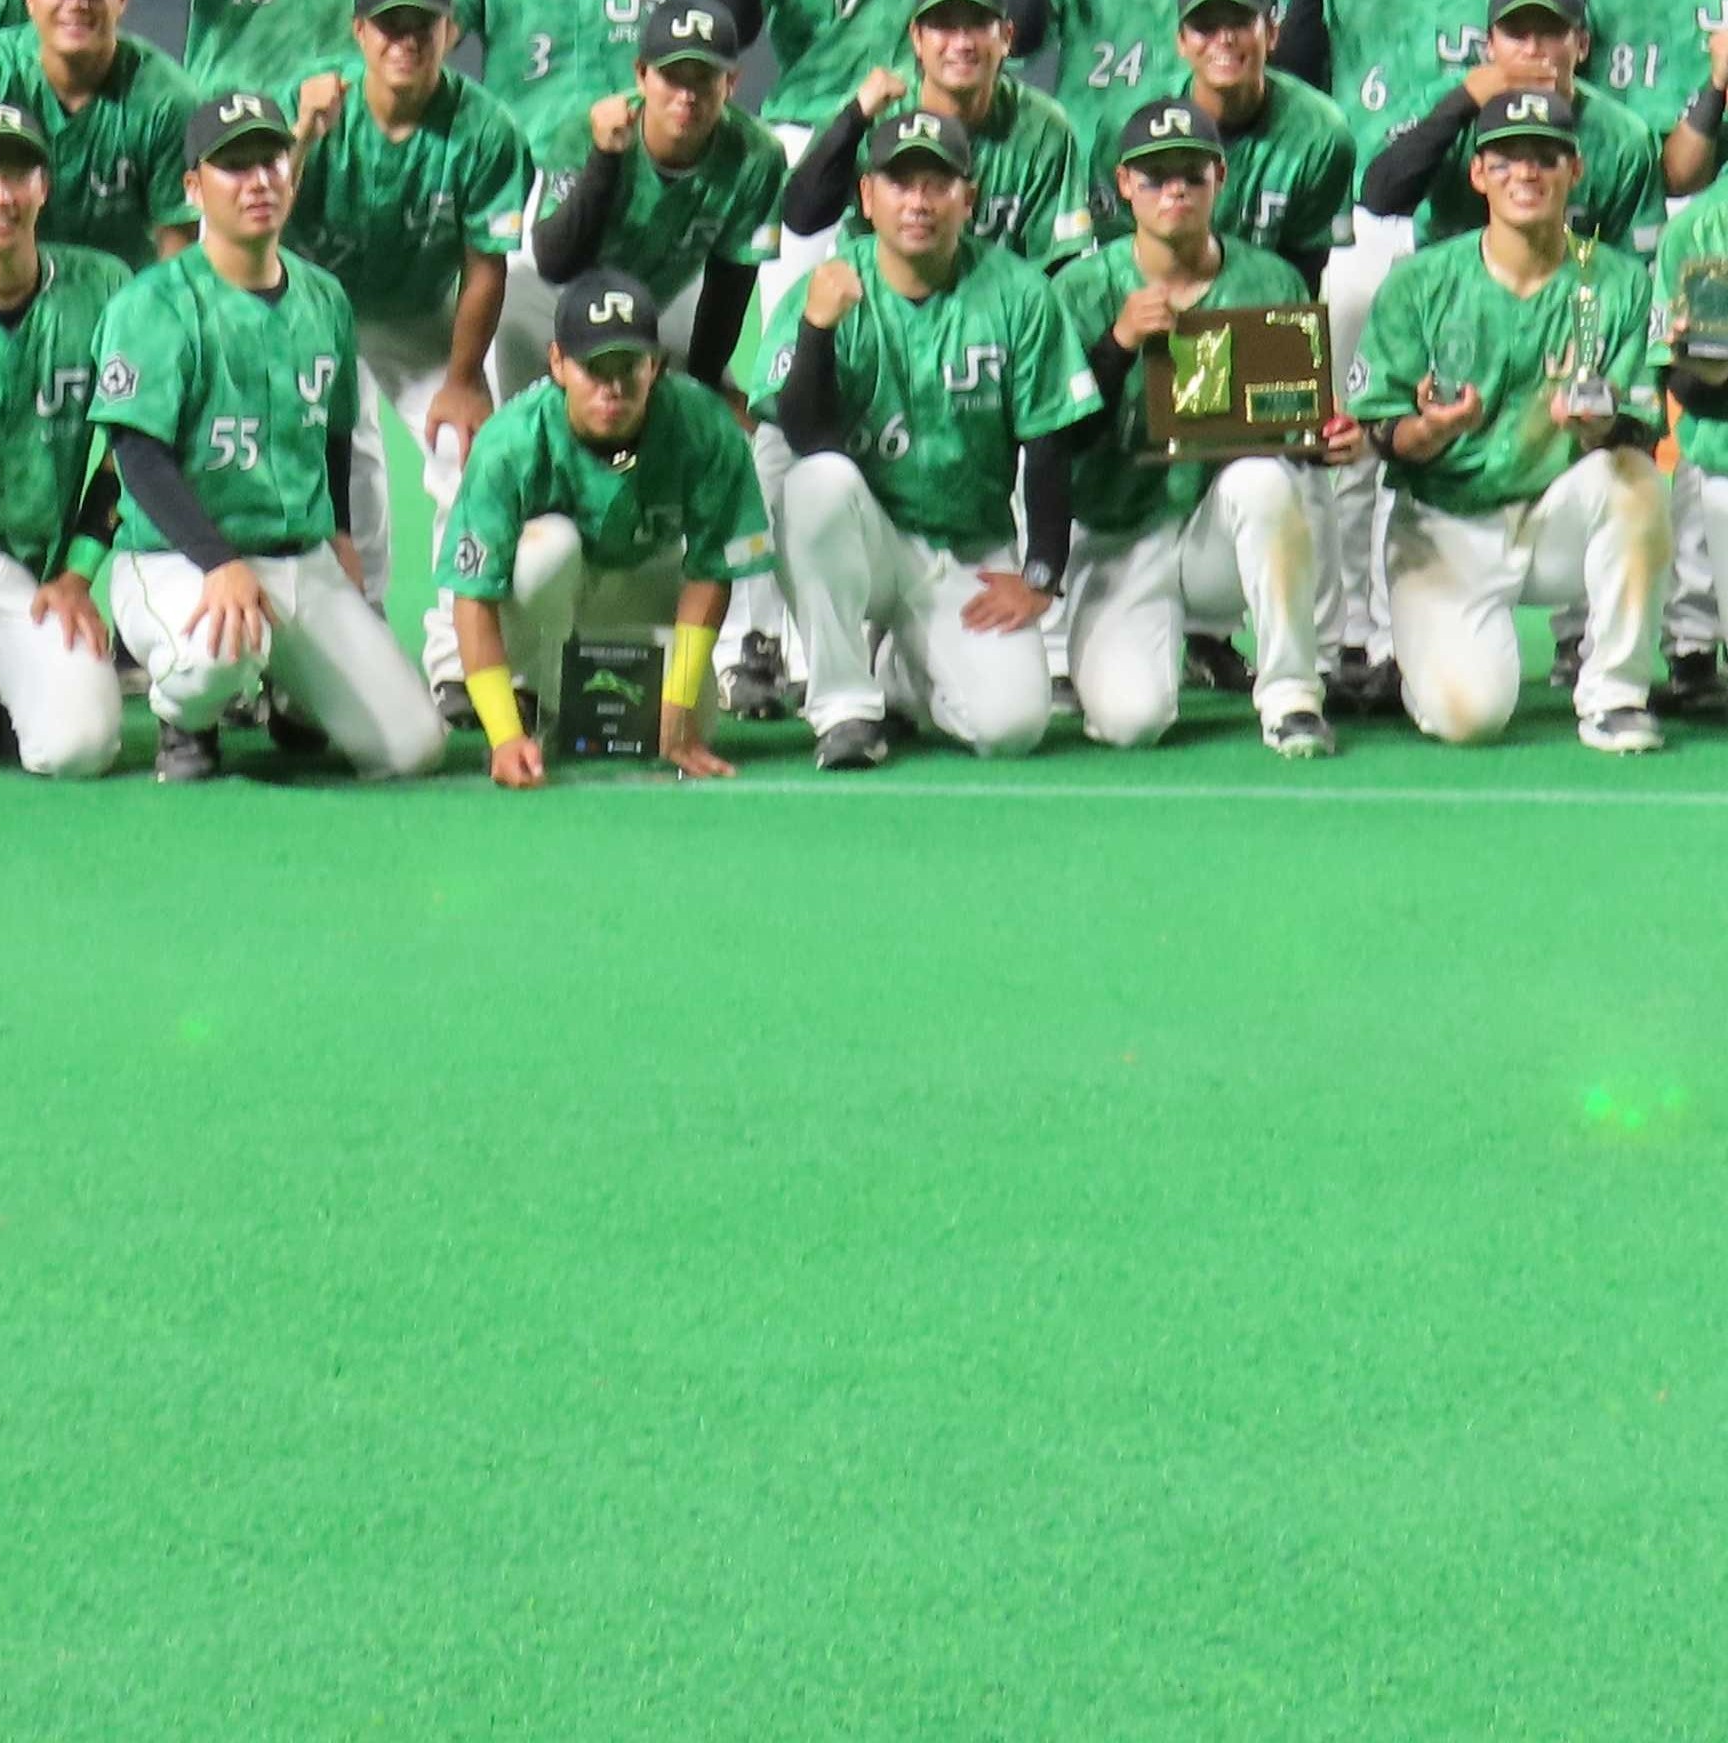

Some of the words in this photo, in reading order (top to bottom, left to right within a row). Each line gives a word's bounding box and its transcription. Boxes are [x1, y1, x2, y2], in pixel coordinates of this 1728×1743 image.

[672, 10, 714, 40] JR
[523, 32, 552, 81] 3
[1086, 40, 1145, 88] 24
[1609, 43, 1659, 90] 81
[1360, 64, 1387, 111] 6
[1506, 93, 1549, 122] JR
[219, 94, 264, 123] JR
[899, 114, 941, 141] JR
[1150, 109, 1192, 138] JR
[589, 292, 633, 325] JR
[943, 344, 1007, 393] JR
[207, 415, 260, 472] 55
